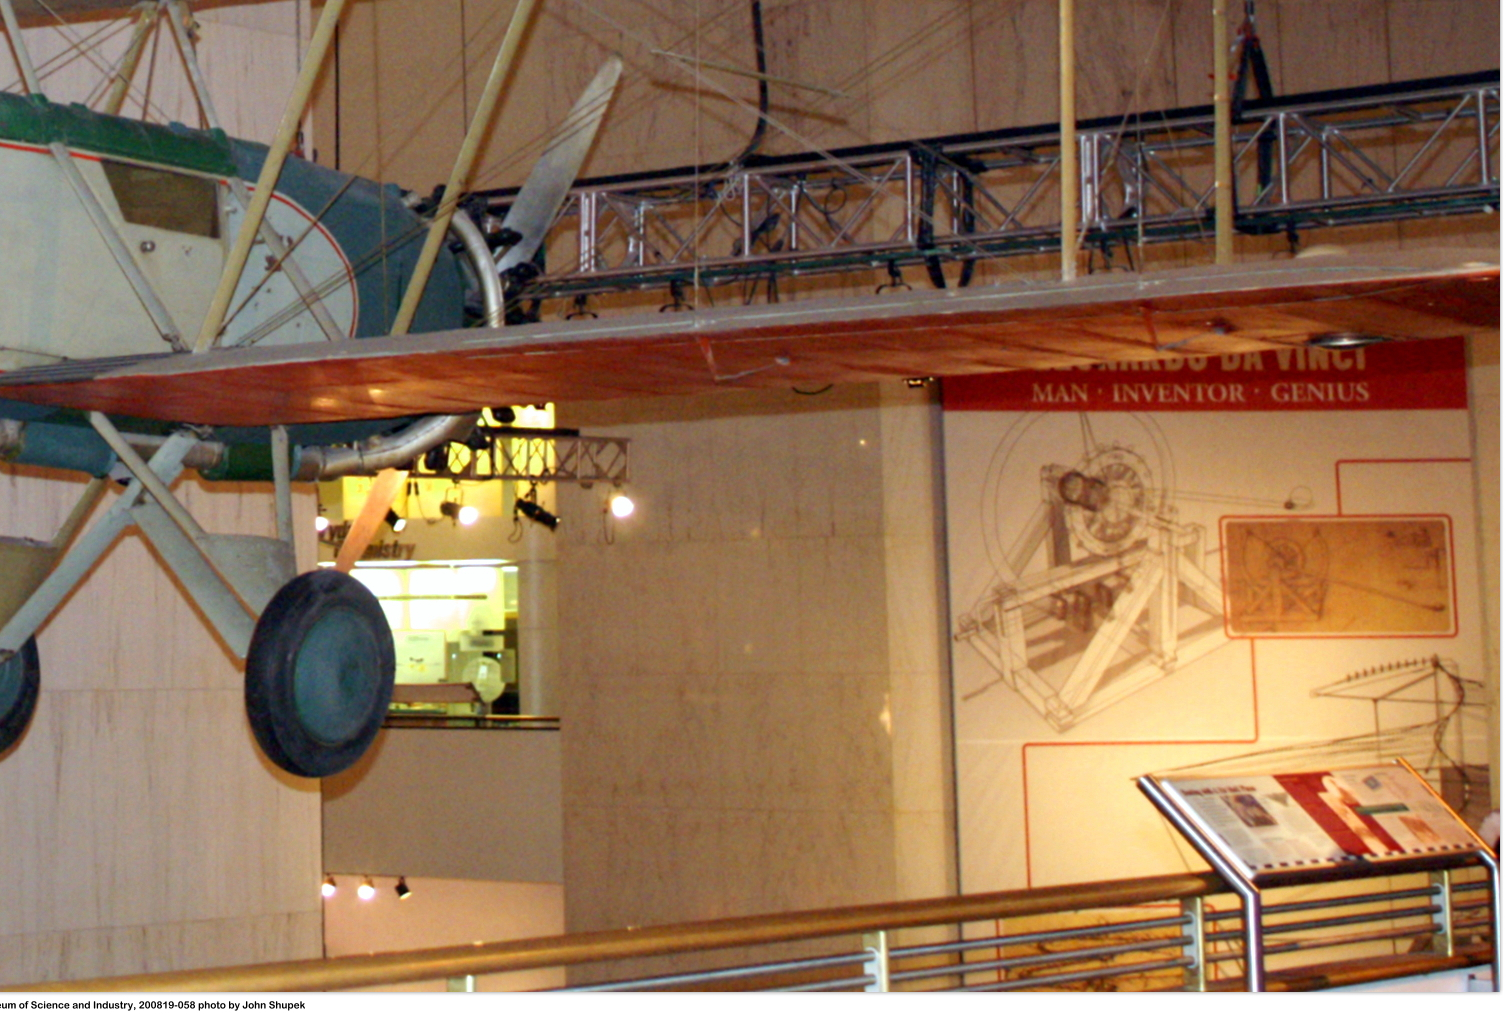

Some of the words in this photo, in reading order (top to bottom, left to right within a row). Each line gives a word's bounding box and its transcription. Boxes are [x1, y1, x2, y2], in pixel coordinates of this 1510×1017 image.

[1032, 382, 1088, 403] MAN
[1112, 382, 1246, 403] INVENTOR
[1270, 382, 1370, 402] GENIUS
